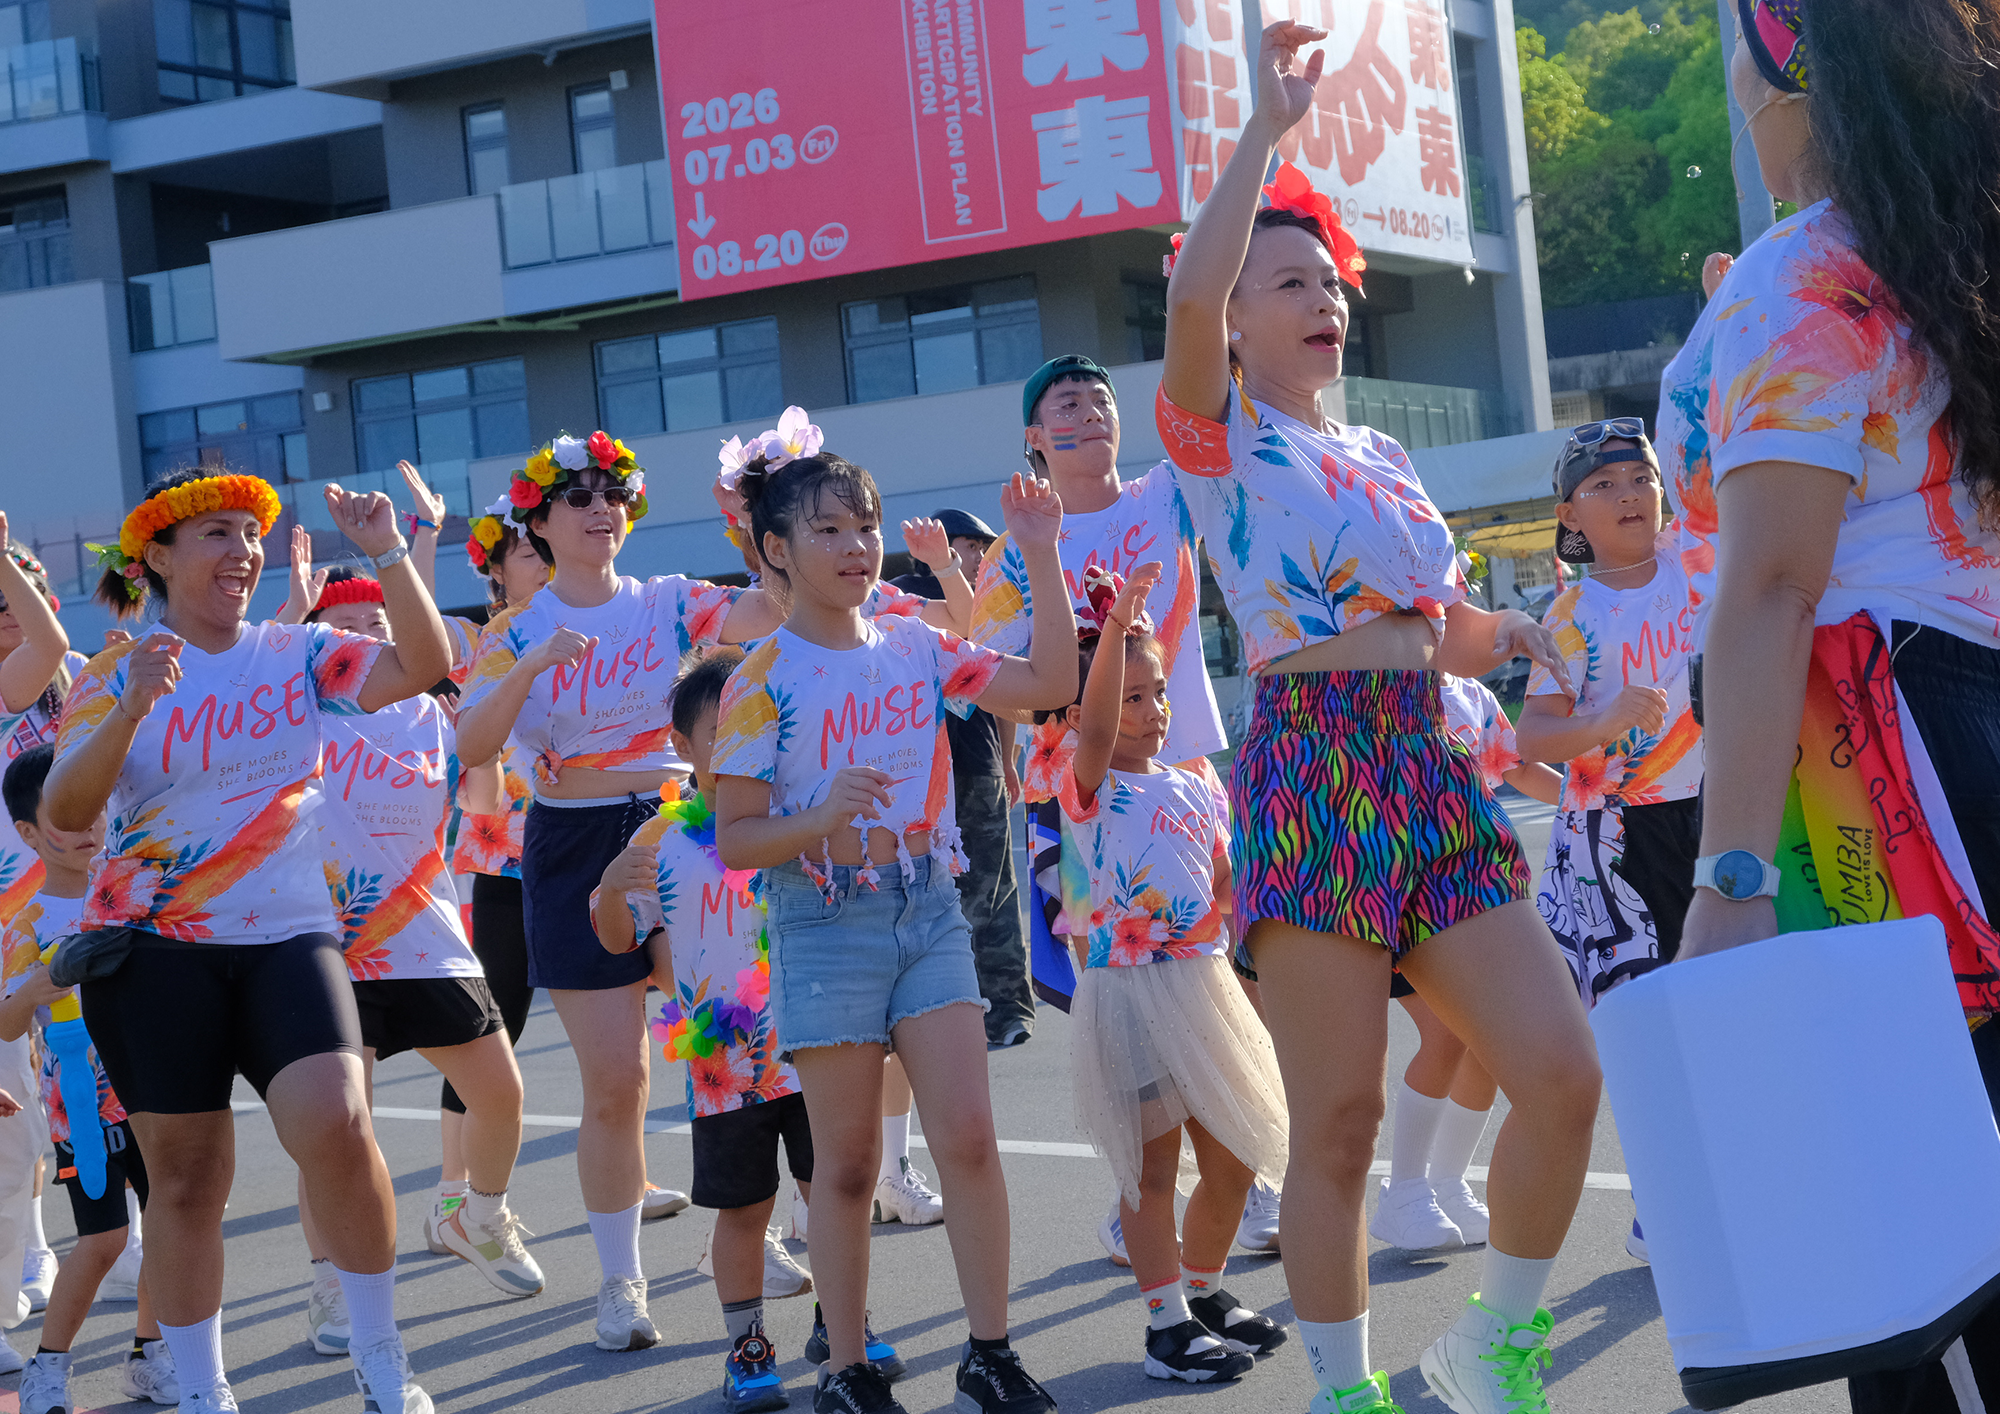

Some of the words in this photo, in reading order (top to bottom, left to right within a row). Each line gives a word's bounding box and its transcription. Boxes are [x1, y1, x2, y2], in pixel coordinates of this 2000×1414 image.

[681, 87, 780, 139] 2026
[684, 133, 796, 185] 07.03
[807, 136, 832, 154] Fri
[950, 162, 973, 226] PLAN
[1390, 206, 1430, 239] 08.20
[693, 229, 805, 280] 08.20
[814, 236, 843, 252] Thu
[219, 762, 242, 776] SHE
[248, 750, 288, 769] MOVES
[246, 763, 294, 783] BLOOMS
[865, 755, 883, 767] SHE
[355, 814, 375, 823] SHE
[379, 815, 422, 826] BLOOMS
[356, 801, 378, 811] SHE
[383, 803, 420, 814] MOVES
[1863, 828, 1874, 856] LOVE
[1837, 825, 1870, 926] UMBA
[1863, 859, 1871, 871] IS
[1864, 874, 1873, 902] LOVE
[742, 929, 757, 939] SHE
